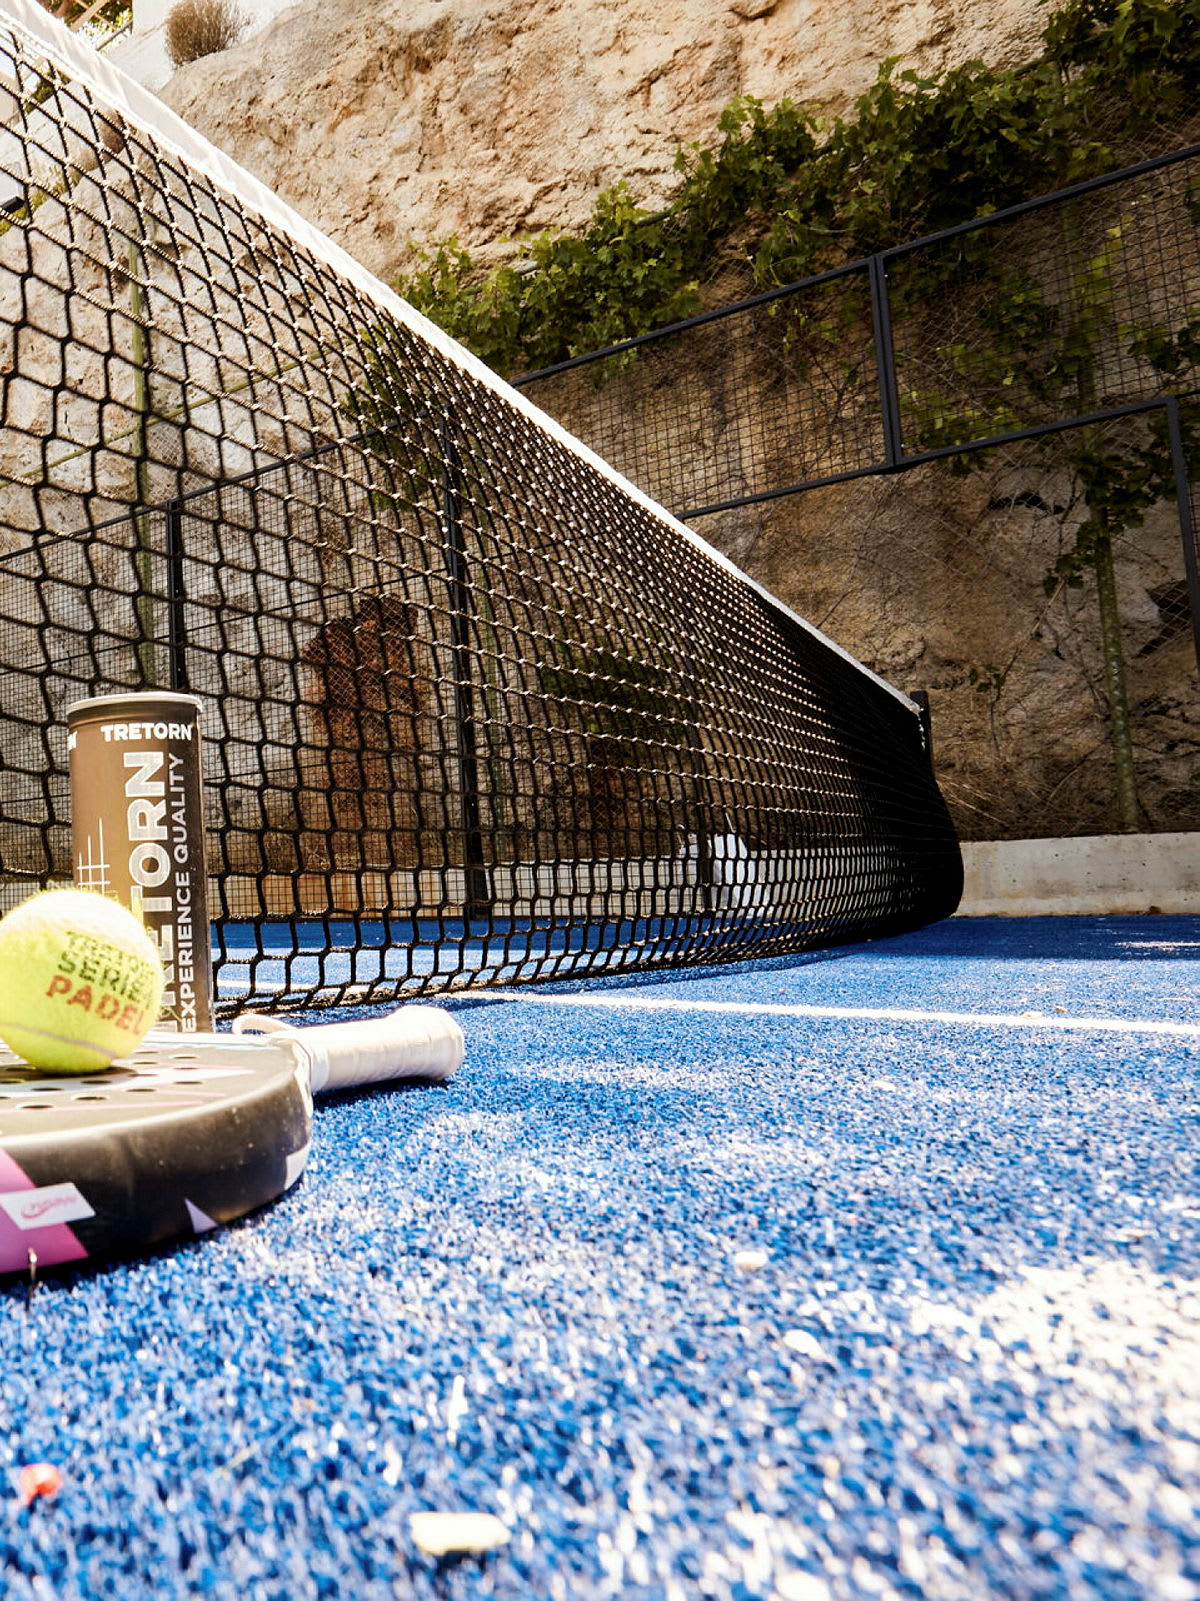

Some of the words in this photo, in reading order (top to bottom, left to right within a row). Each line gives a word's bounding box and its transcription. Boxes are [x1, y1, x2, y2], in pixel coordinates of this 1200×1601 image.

[100, 722, 193, 742] TRETORN
[168, 752, 189, 864] QUALITY
[123, 751, 178, 1032] ETORN
[45, 975, 145, 1036] PADEL
[175, 871, 197, 1033] EXPERIENCE
